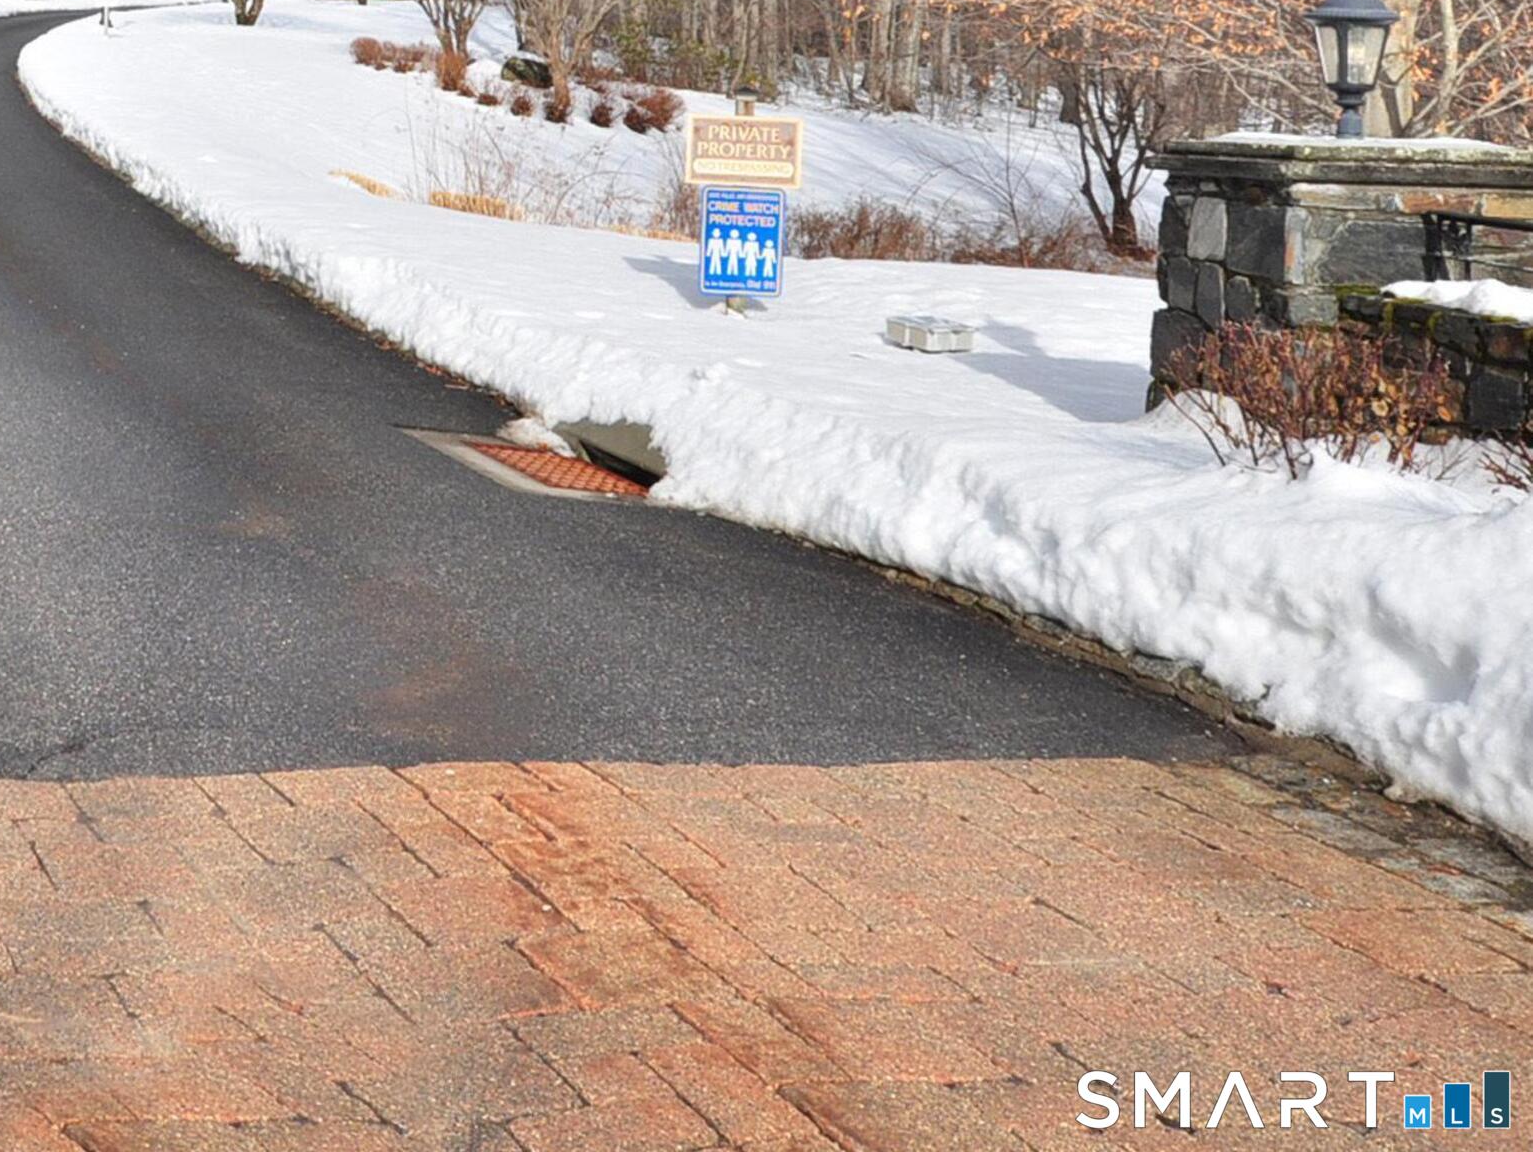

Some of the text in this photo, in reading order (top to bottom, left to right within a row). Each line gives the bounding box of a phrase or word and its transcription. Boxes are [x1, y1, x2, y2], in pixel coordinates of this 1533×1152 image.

[708, 125, 780, 143] PRIVATE
[697, 141, 791, 159] PROPERTY
[708, 200, 779, 215] CRIME WATCH
[708, 213, 776, 228] PROTECTED
